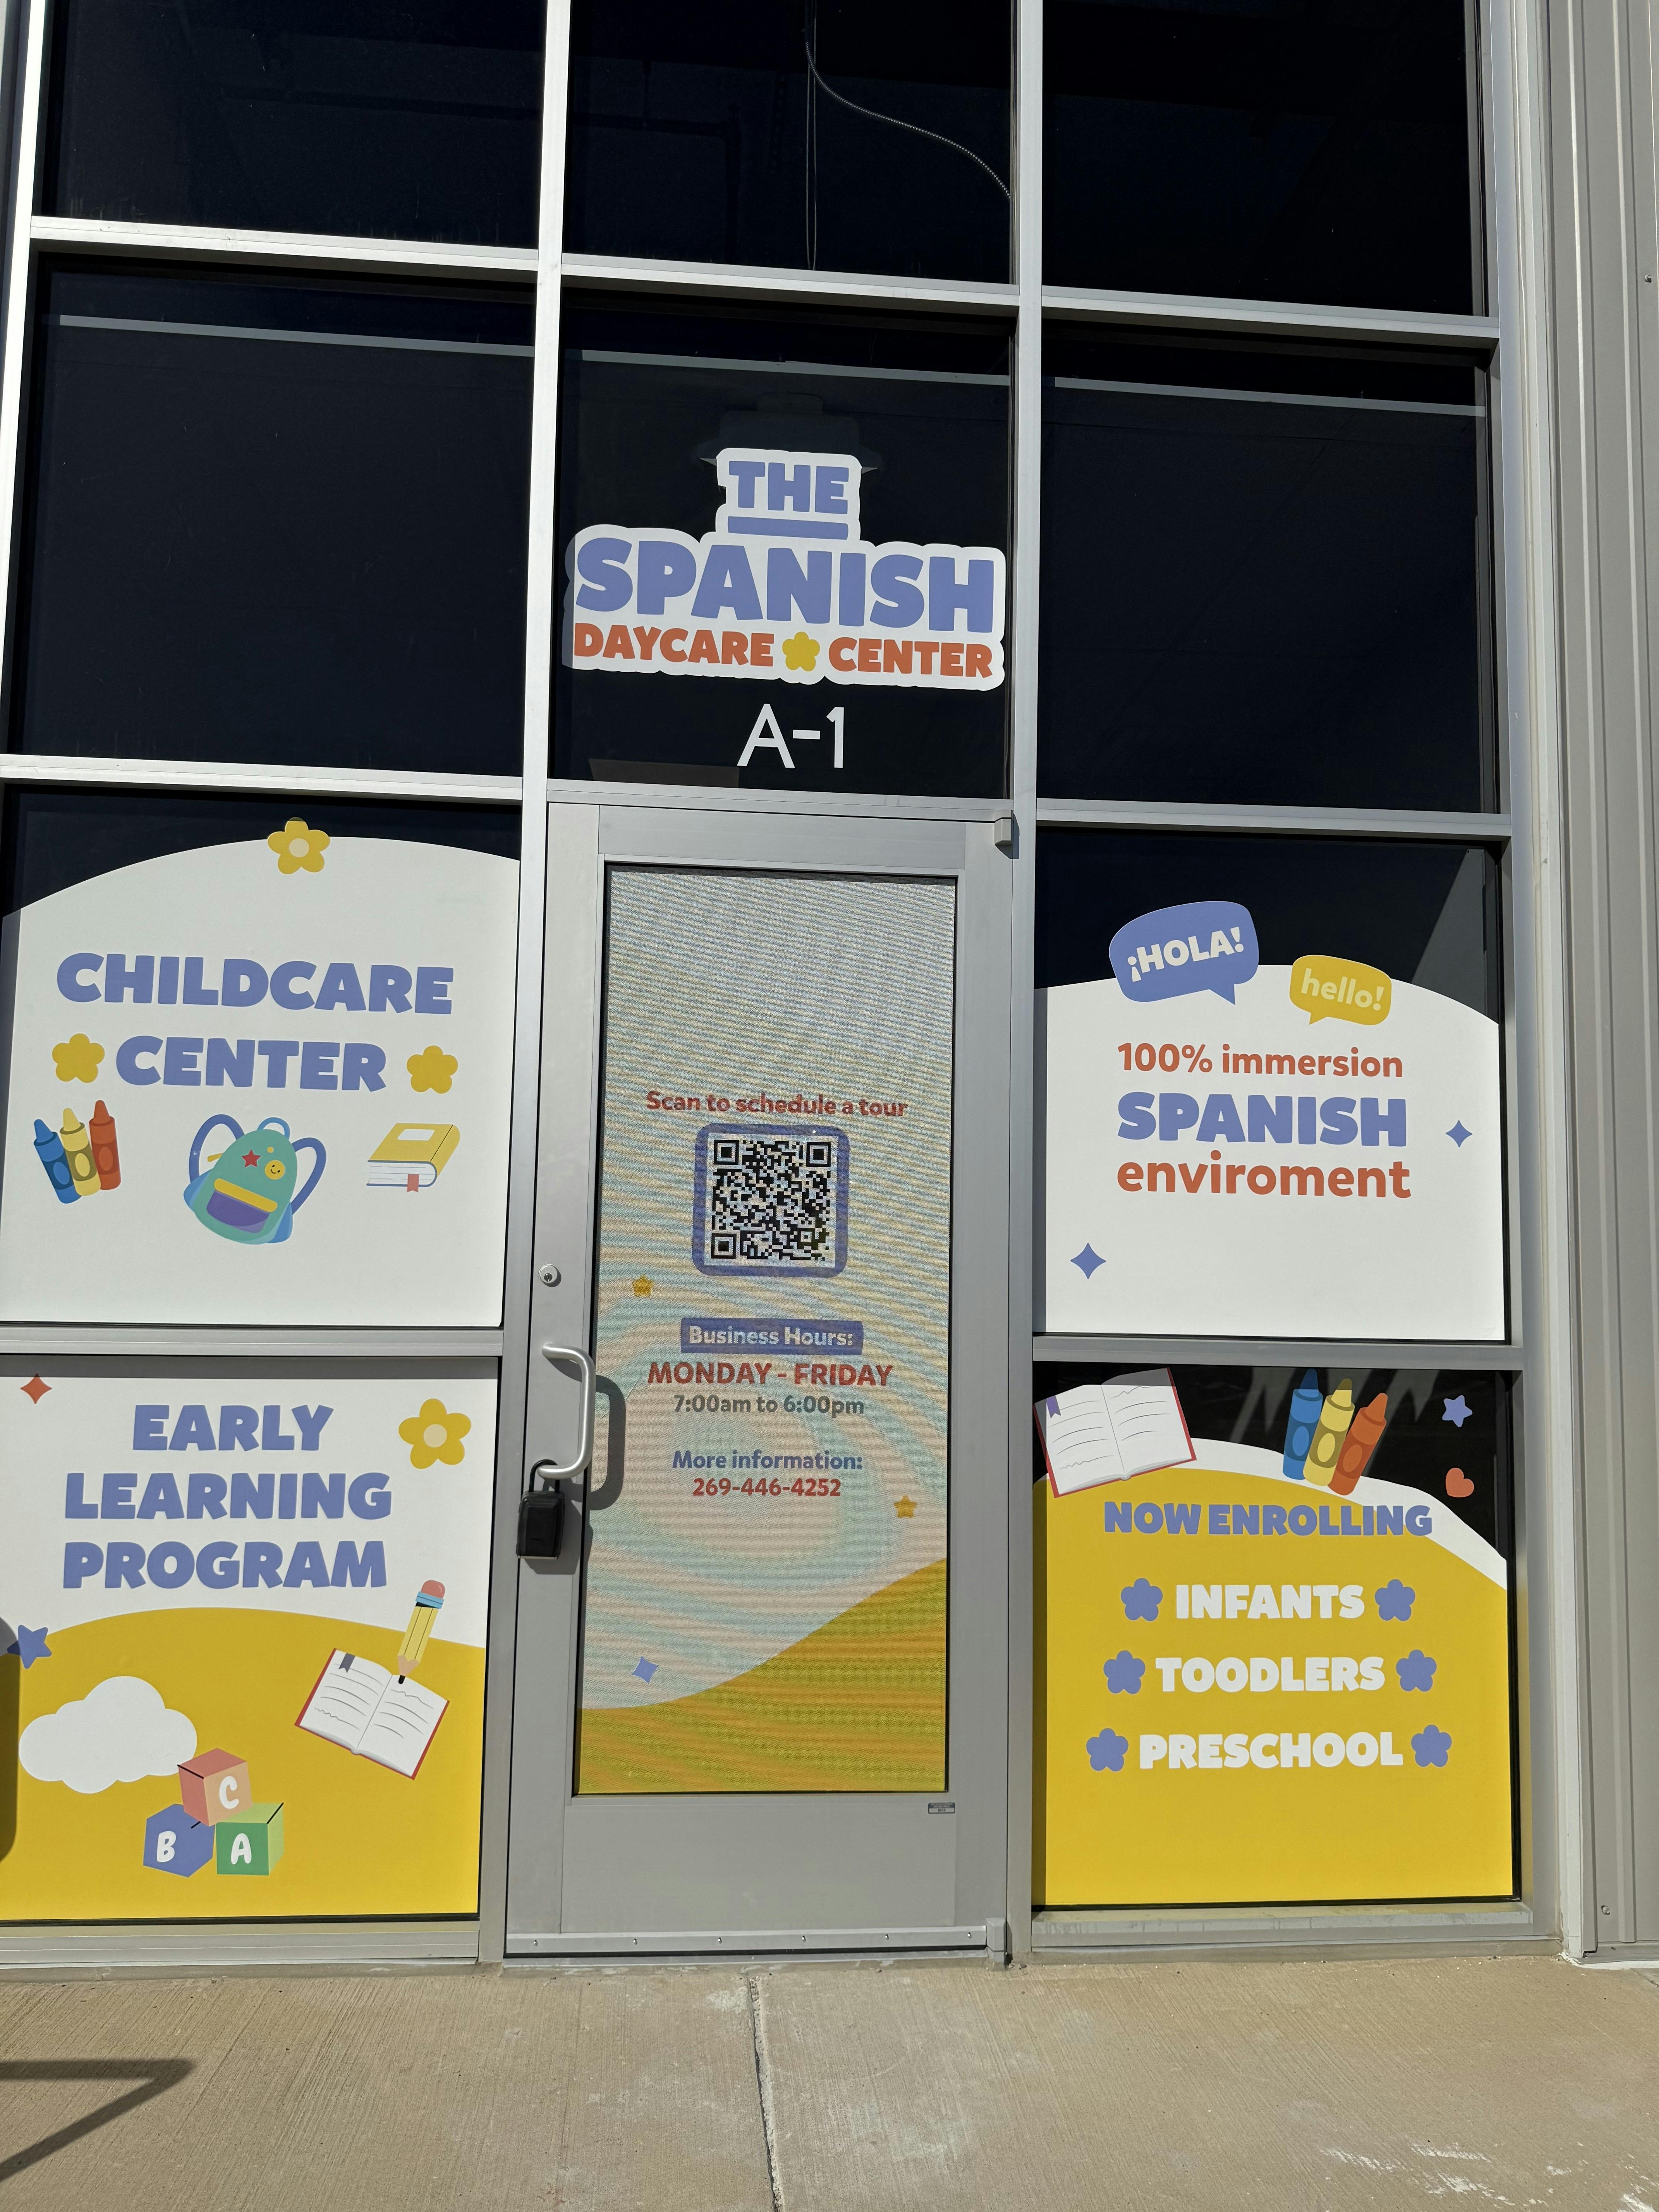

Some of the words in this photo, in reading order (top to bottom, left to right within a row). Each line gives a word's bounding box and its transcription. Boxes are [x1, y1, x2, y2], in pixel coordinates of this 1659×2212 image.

[729, 461, 848, 514] THE
[576, 537, 994, 633] SPANISH
[574, 622, 774, 666] DAYCARE
[829, 637, 993, 678] CENTER
[737, 703, 844, 768] A-1
[1127, 926, 1244, 982] ¡HOLA!
[57, 952, 454, 1015] CHILDCARE
[1302, 968, 1384, 1011] hello!
[116, 1036, 386, 1092] CENTER
[1118, 1042, 1212, 1073] 100%
[1222, 1044, 1403, 1077] immersion
[646, 1091, 701, 1111] Scan
[706, 1094, 730, 1112] to
[736, 1092, 835, 1114] schedule
[842, 1101, 853, 1115] a
[859, 1099, 907, 1116] tour
[1118, 1092, 1407, 1147] SPANISH
[1117, 1150, 1411, 1198] enviroment
[689, 1325, 779, 1345] Business
[785, 1327, 854, 1346] Hours:
[647, 1362, 771, 1384] MONDAY
[795, 1364, 893, 1386] FRIDAY
[674, 1395, 750, 1412] 7:00am
[756, 1397, 778, 1413] to
[783, 1395, 864, 1418] 6:00pm
[132, 1405, 334, 1451] EARLY
[673, 1450, 726, 1469] More
[733, 1450, 862, 1470] information:
[64, 1472, 392, 1520] LEARNING
[693, 1478, 841, 1497] 269-446-4252
[1104, 1501, 1202, 1535] NOW
[1208, 1504, 1432, 1536] ENROLLING
[63, 1541, 386, 1589] PROGRAM
[1176, 1584, 1365, 1620] INFANTS
[1156, 1657, 1385, 1692] TOODLERS
[1139, 1731, 1403, 1769] PRESCHOOL
[219, 1776, 239, 1809] C
[156, 1831, 176, 1862] B
[230, 1833, 252, 1865] A
